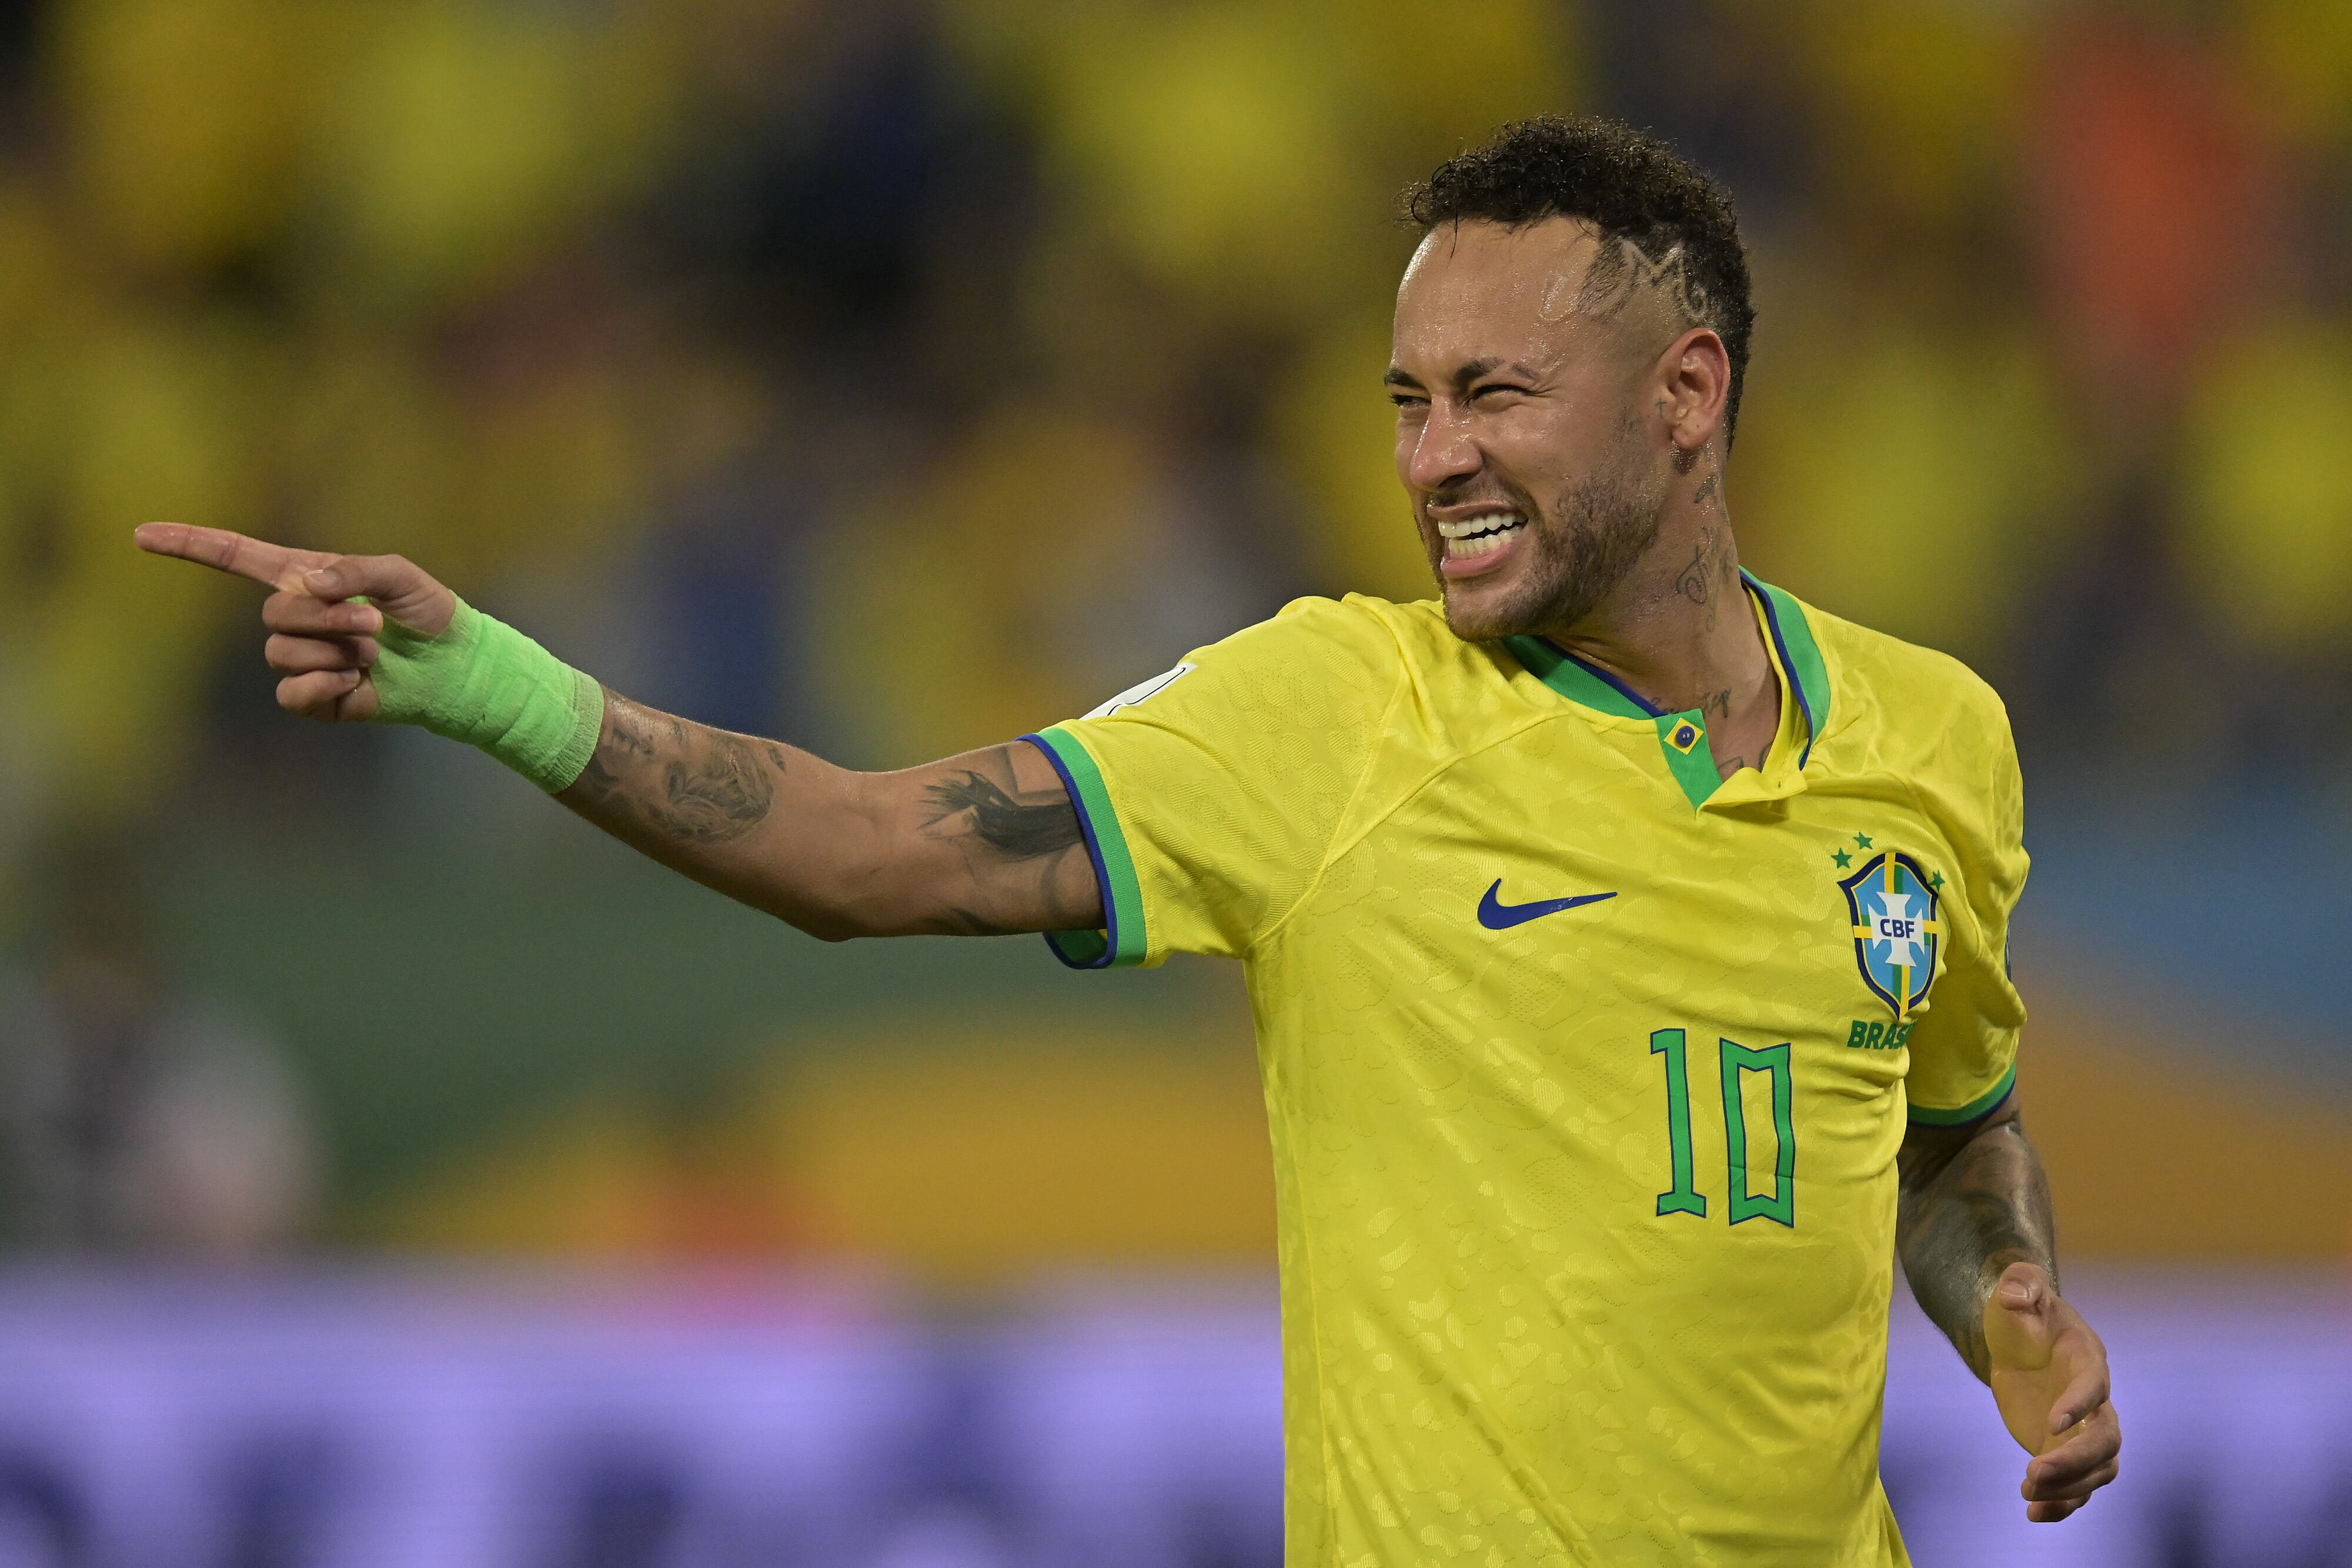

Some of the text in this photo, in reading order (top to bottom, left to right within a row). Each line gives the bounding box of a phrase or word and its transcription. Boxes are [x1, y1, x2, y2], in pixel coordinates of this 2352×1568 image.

[1880, 918, 1915, 938] CBF
[1847, 1020, 1917, 1049] BRAS
[1650, 1028, 1796, 1228] 10
